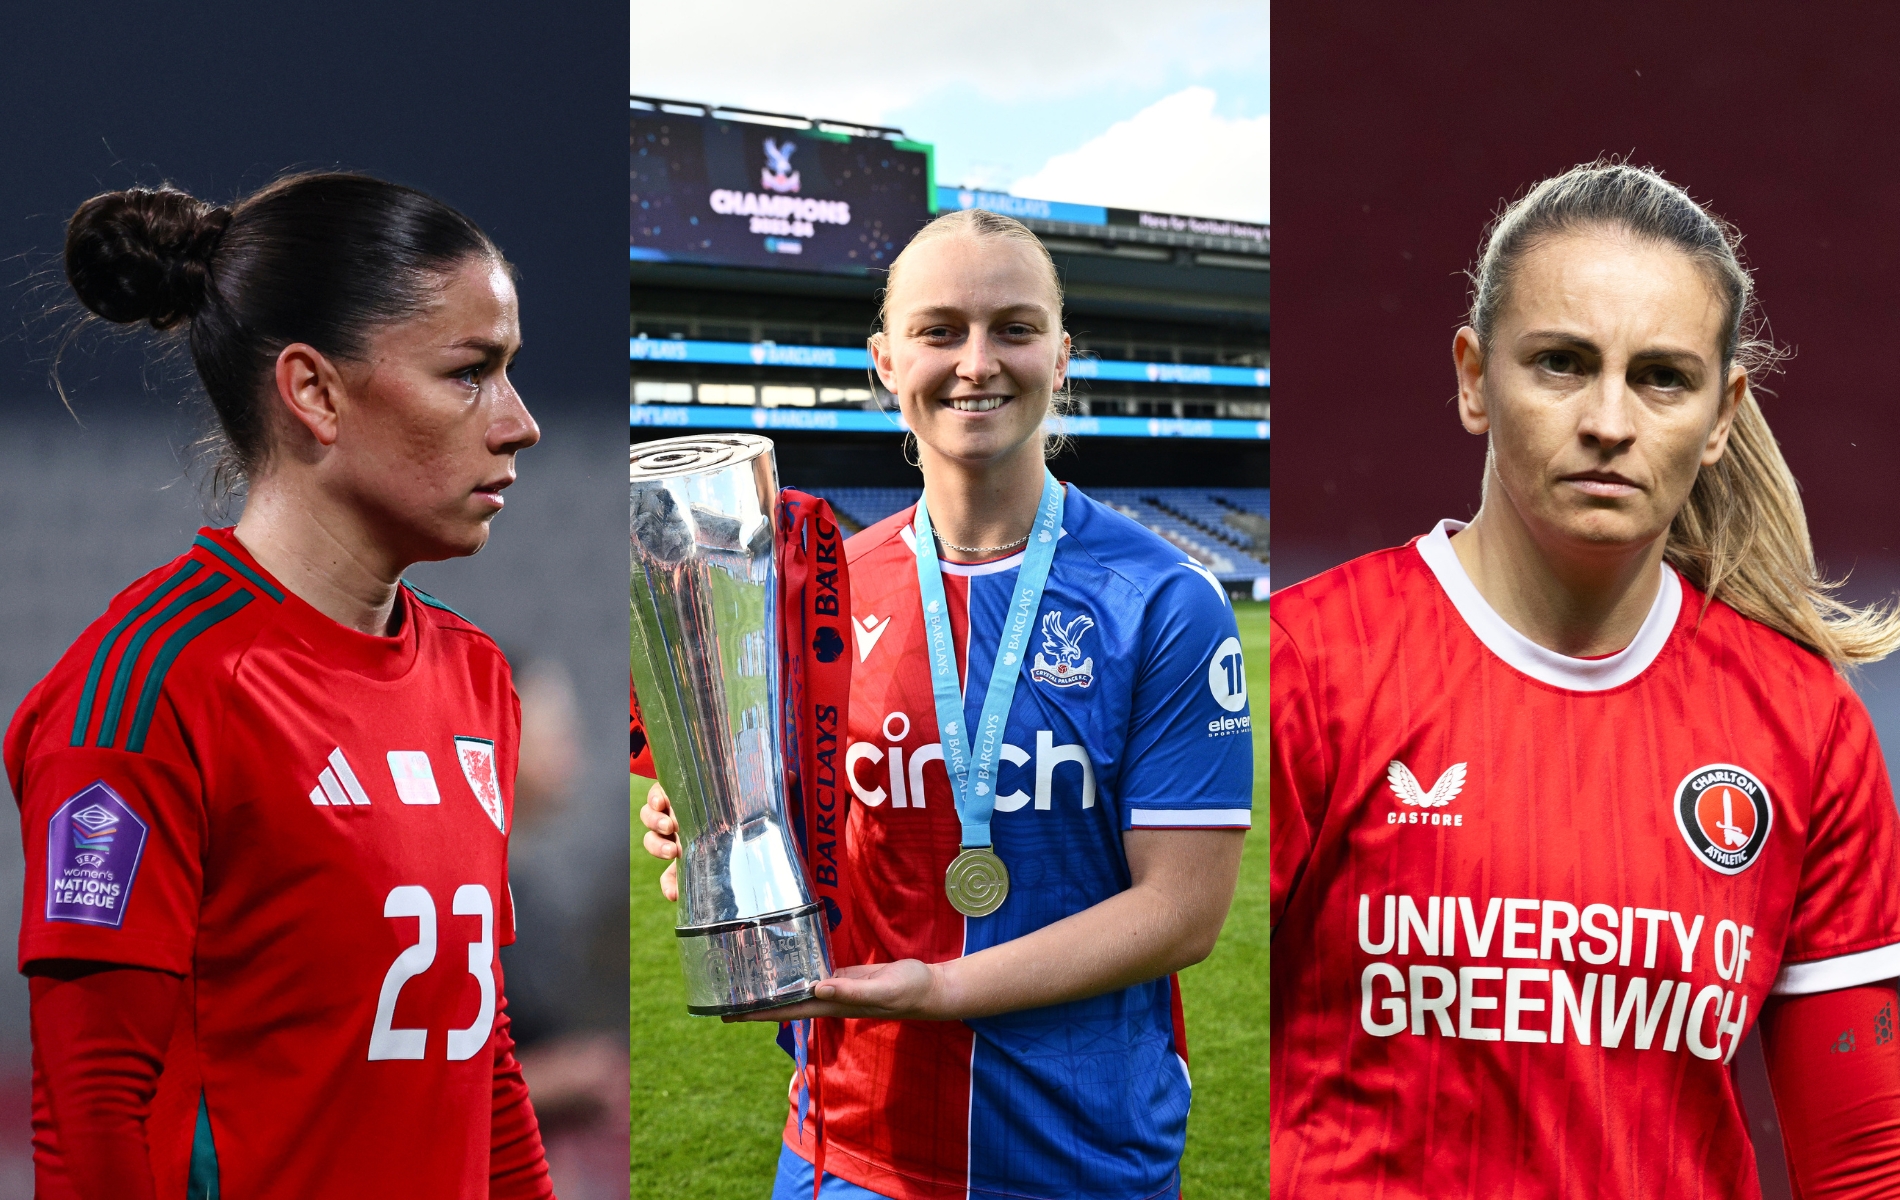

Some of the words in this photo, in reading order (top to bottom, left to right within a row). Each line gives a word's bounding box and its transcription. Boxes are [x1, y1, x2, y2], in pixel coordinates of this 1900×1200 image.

[709, 189, 850, 225] CHAMPIONS
[1008, 588, 1034, 650] BARCLAYS
[930, 616, 949, 676] BARCLAYS
[1035, 670, 1057, 684] CRYSTAL
[1057, 674, 1079, 684] PALACE
[978, 715, 999, 780] BARCLAYS
[815, 704, 838, 888] BARCLAYS
[1691, 771, 1758, 796] CHARLTON
[1387, 811, 1463, 826] CASTORE
[76, 854, 103, 868] UEFA
[1704, 845, 1748, 866] ATHLETIC
[54, 878, 121, 897] NATIONS
[63, 867, 114, 881] women's
[55, 891, 115, 909] LEAGUE
[1357, 894, 1705, 973] UNIVERSITY
[1714, 918, 1754, 984] OF
[367, 884, 496, 1062] 23
[1360, 962, 1749, 1066] GREENWICH
